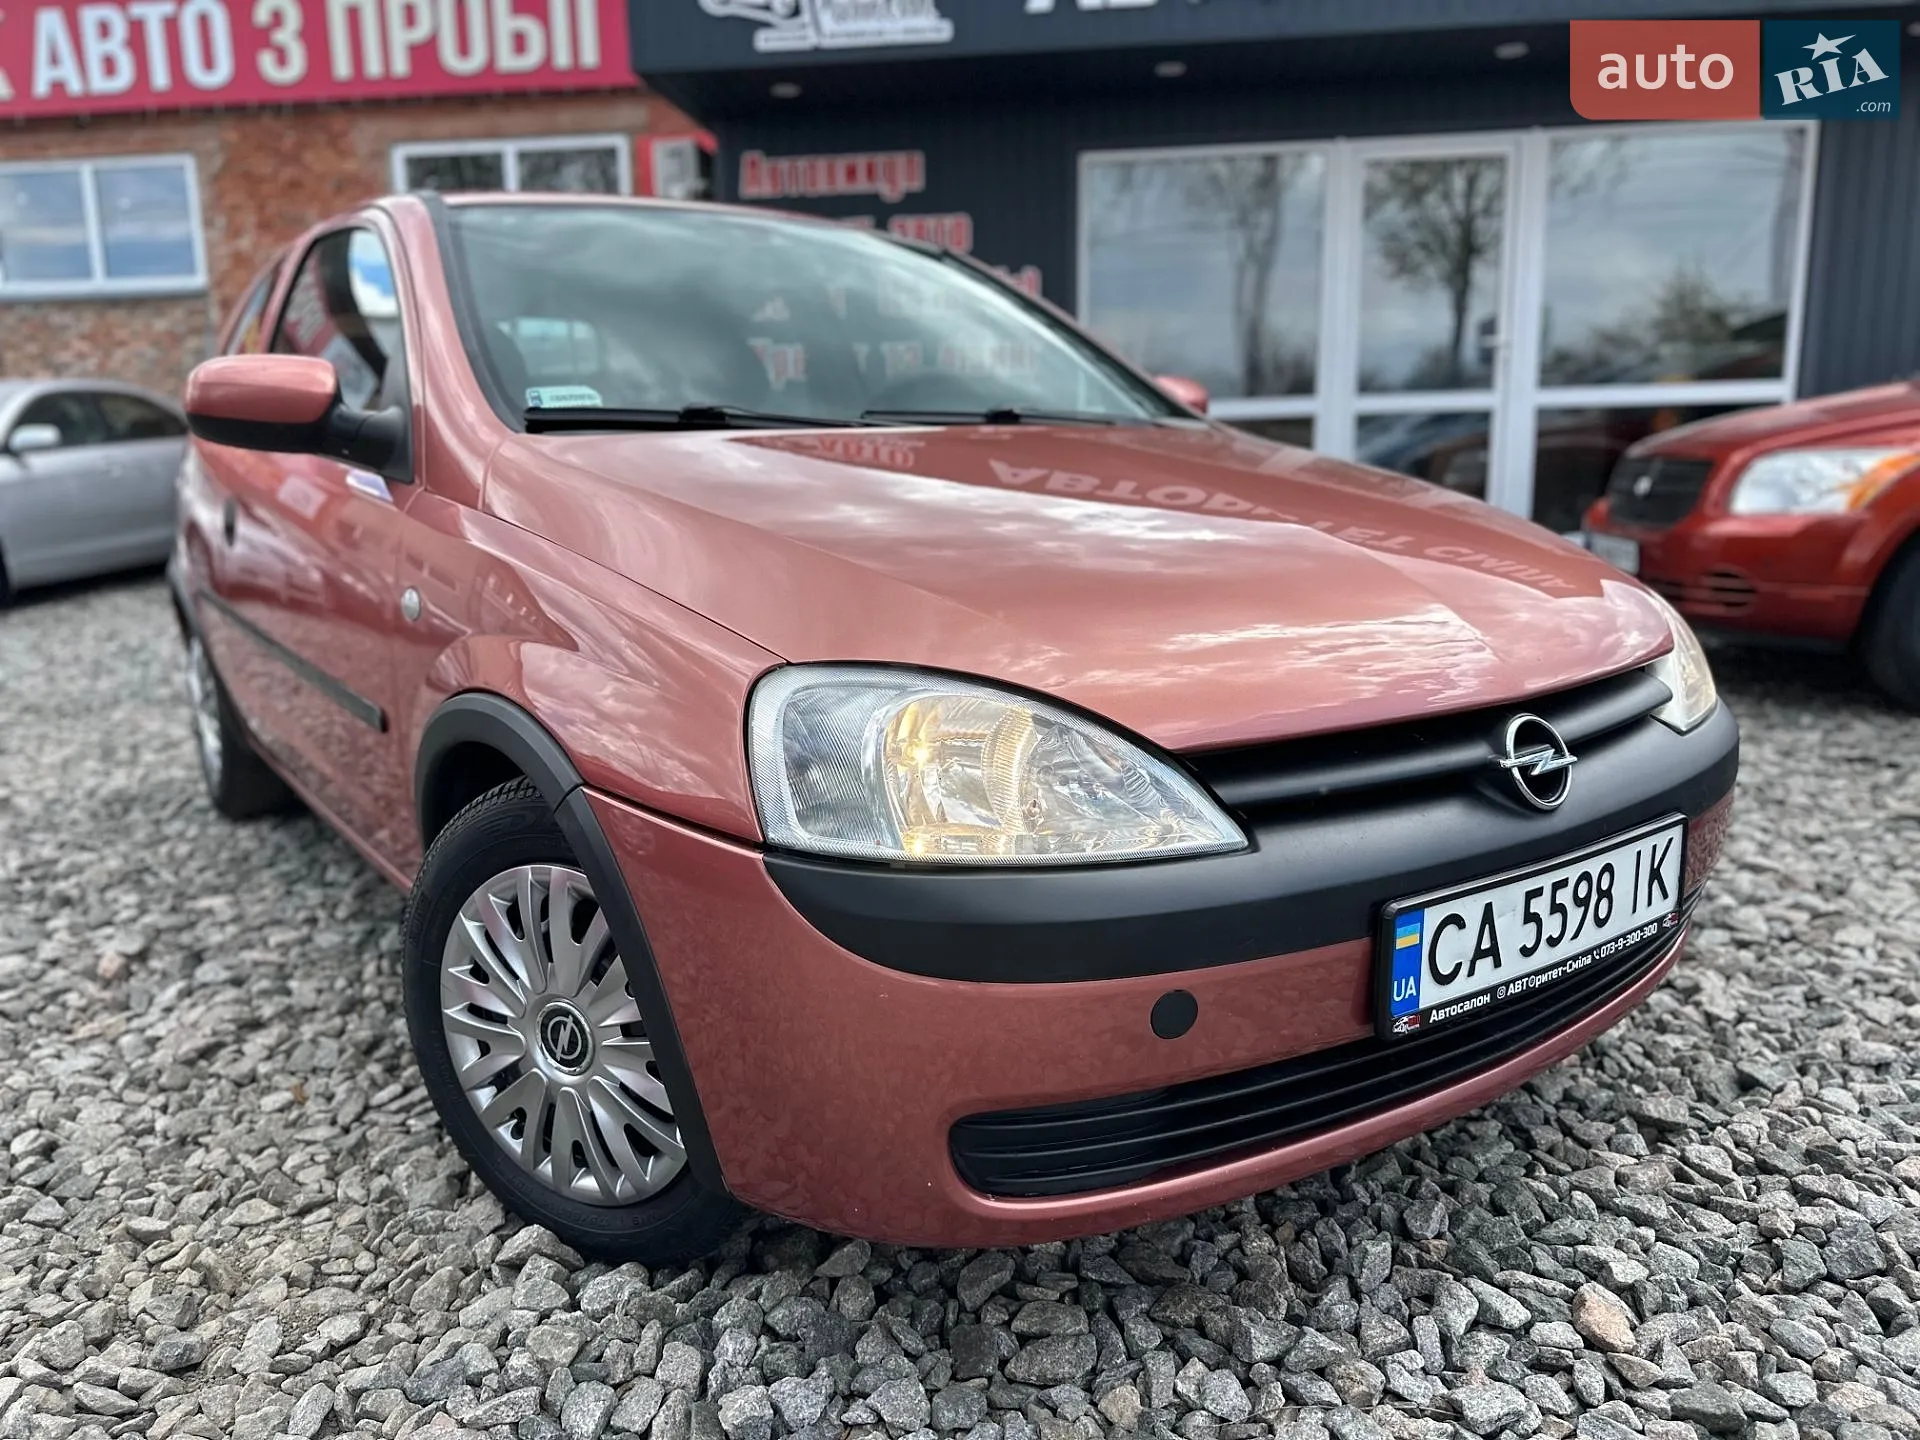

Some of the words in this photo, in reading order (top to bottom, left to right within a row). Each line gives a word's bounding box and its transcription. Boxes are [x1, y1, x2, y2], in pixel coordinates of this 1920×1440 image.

[31, 0, 236, 98] АВТО
[1427, 901, 1503, 987] CA
[1518, 862, 1615, 958] 5598
[1429, 992, 1491, 1024] Автосалон
[1600, 922, 1658, 958] 073-9-300-300
[1392, 975, 1417, 1002] UA
